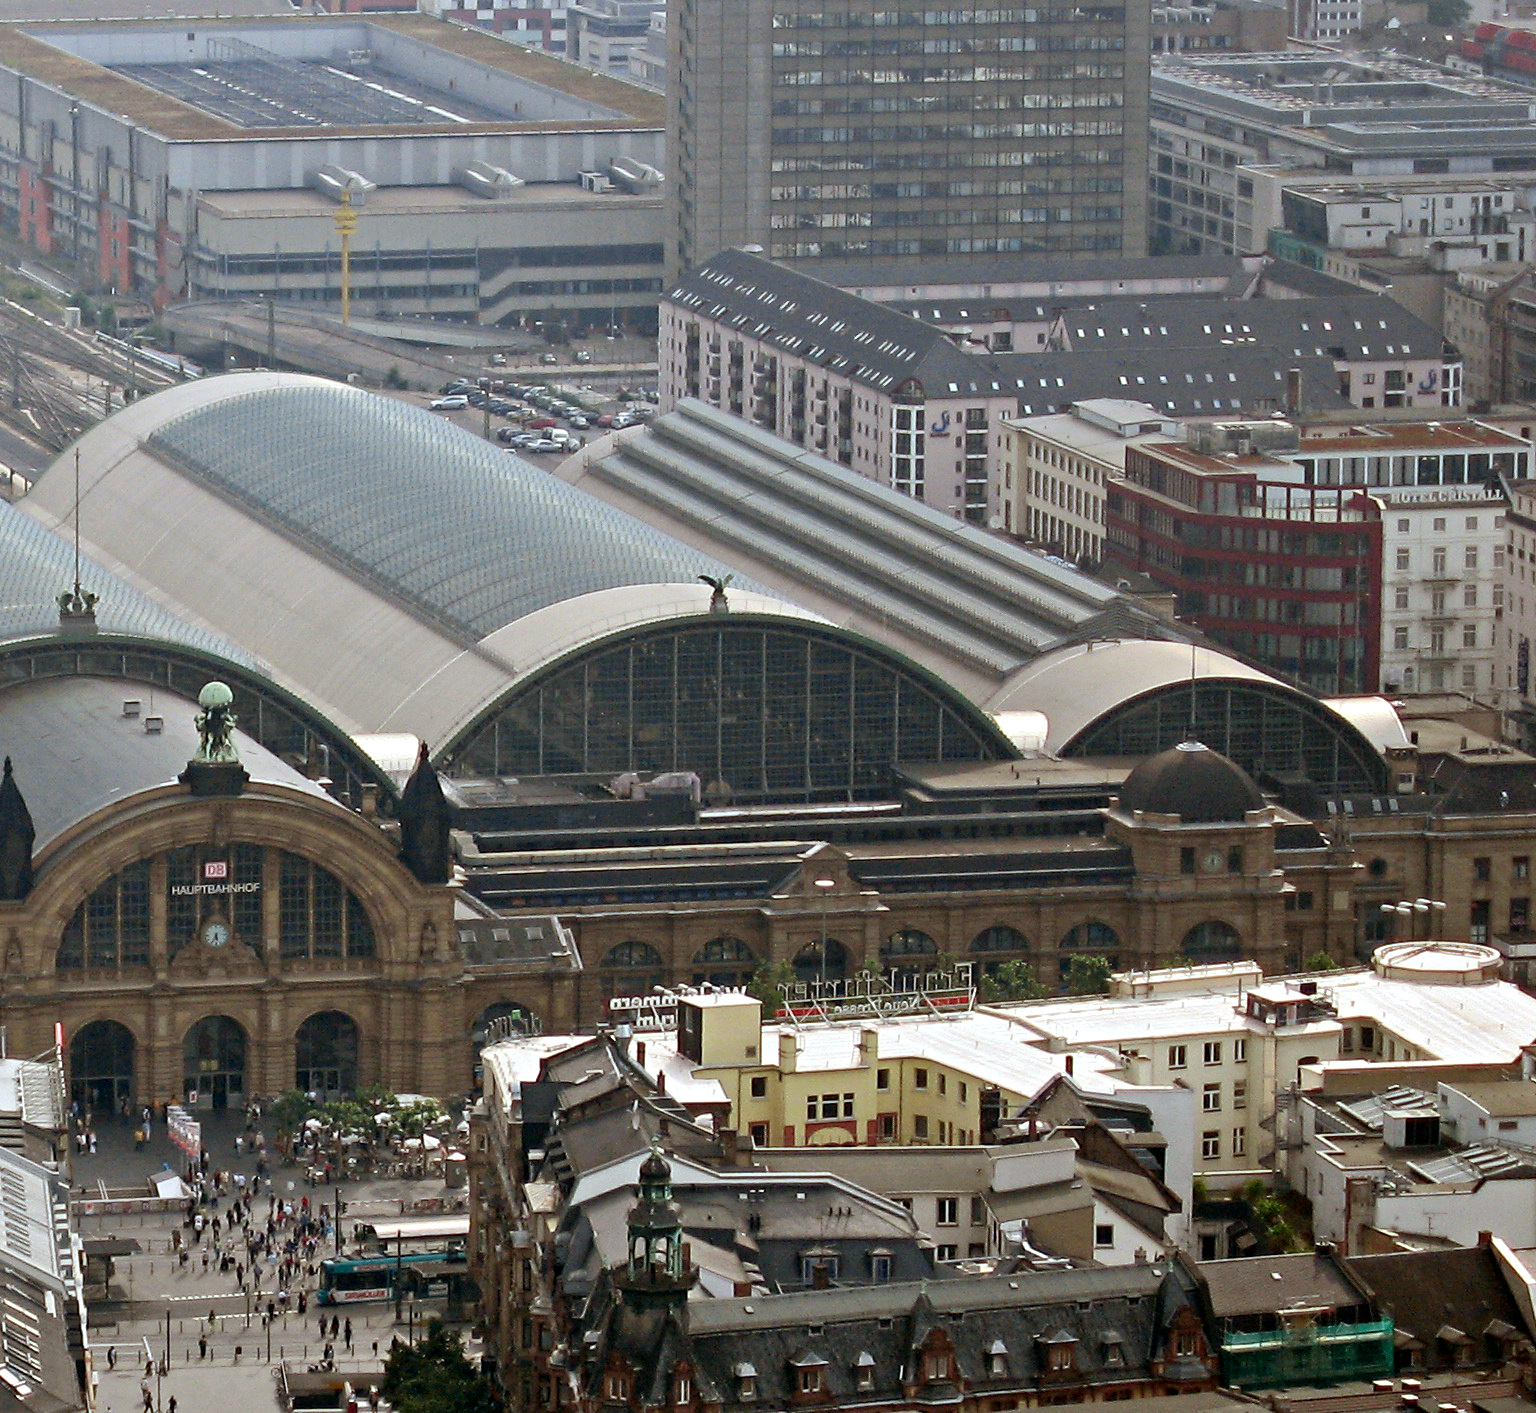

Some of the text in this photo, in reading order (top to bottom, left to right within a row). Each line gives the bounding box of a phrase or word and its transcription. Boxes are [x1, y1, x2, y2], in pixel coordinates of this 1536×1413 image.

[1391, 489, 1504, 504] HOTEL CRISTALL
[206, 863, 227, 878] DB
[171, 882, 261, 895] HAUPTBAHNHOF
